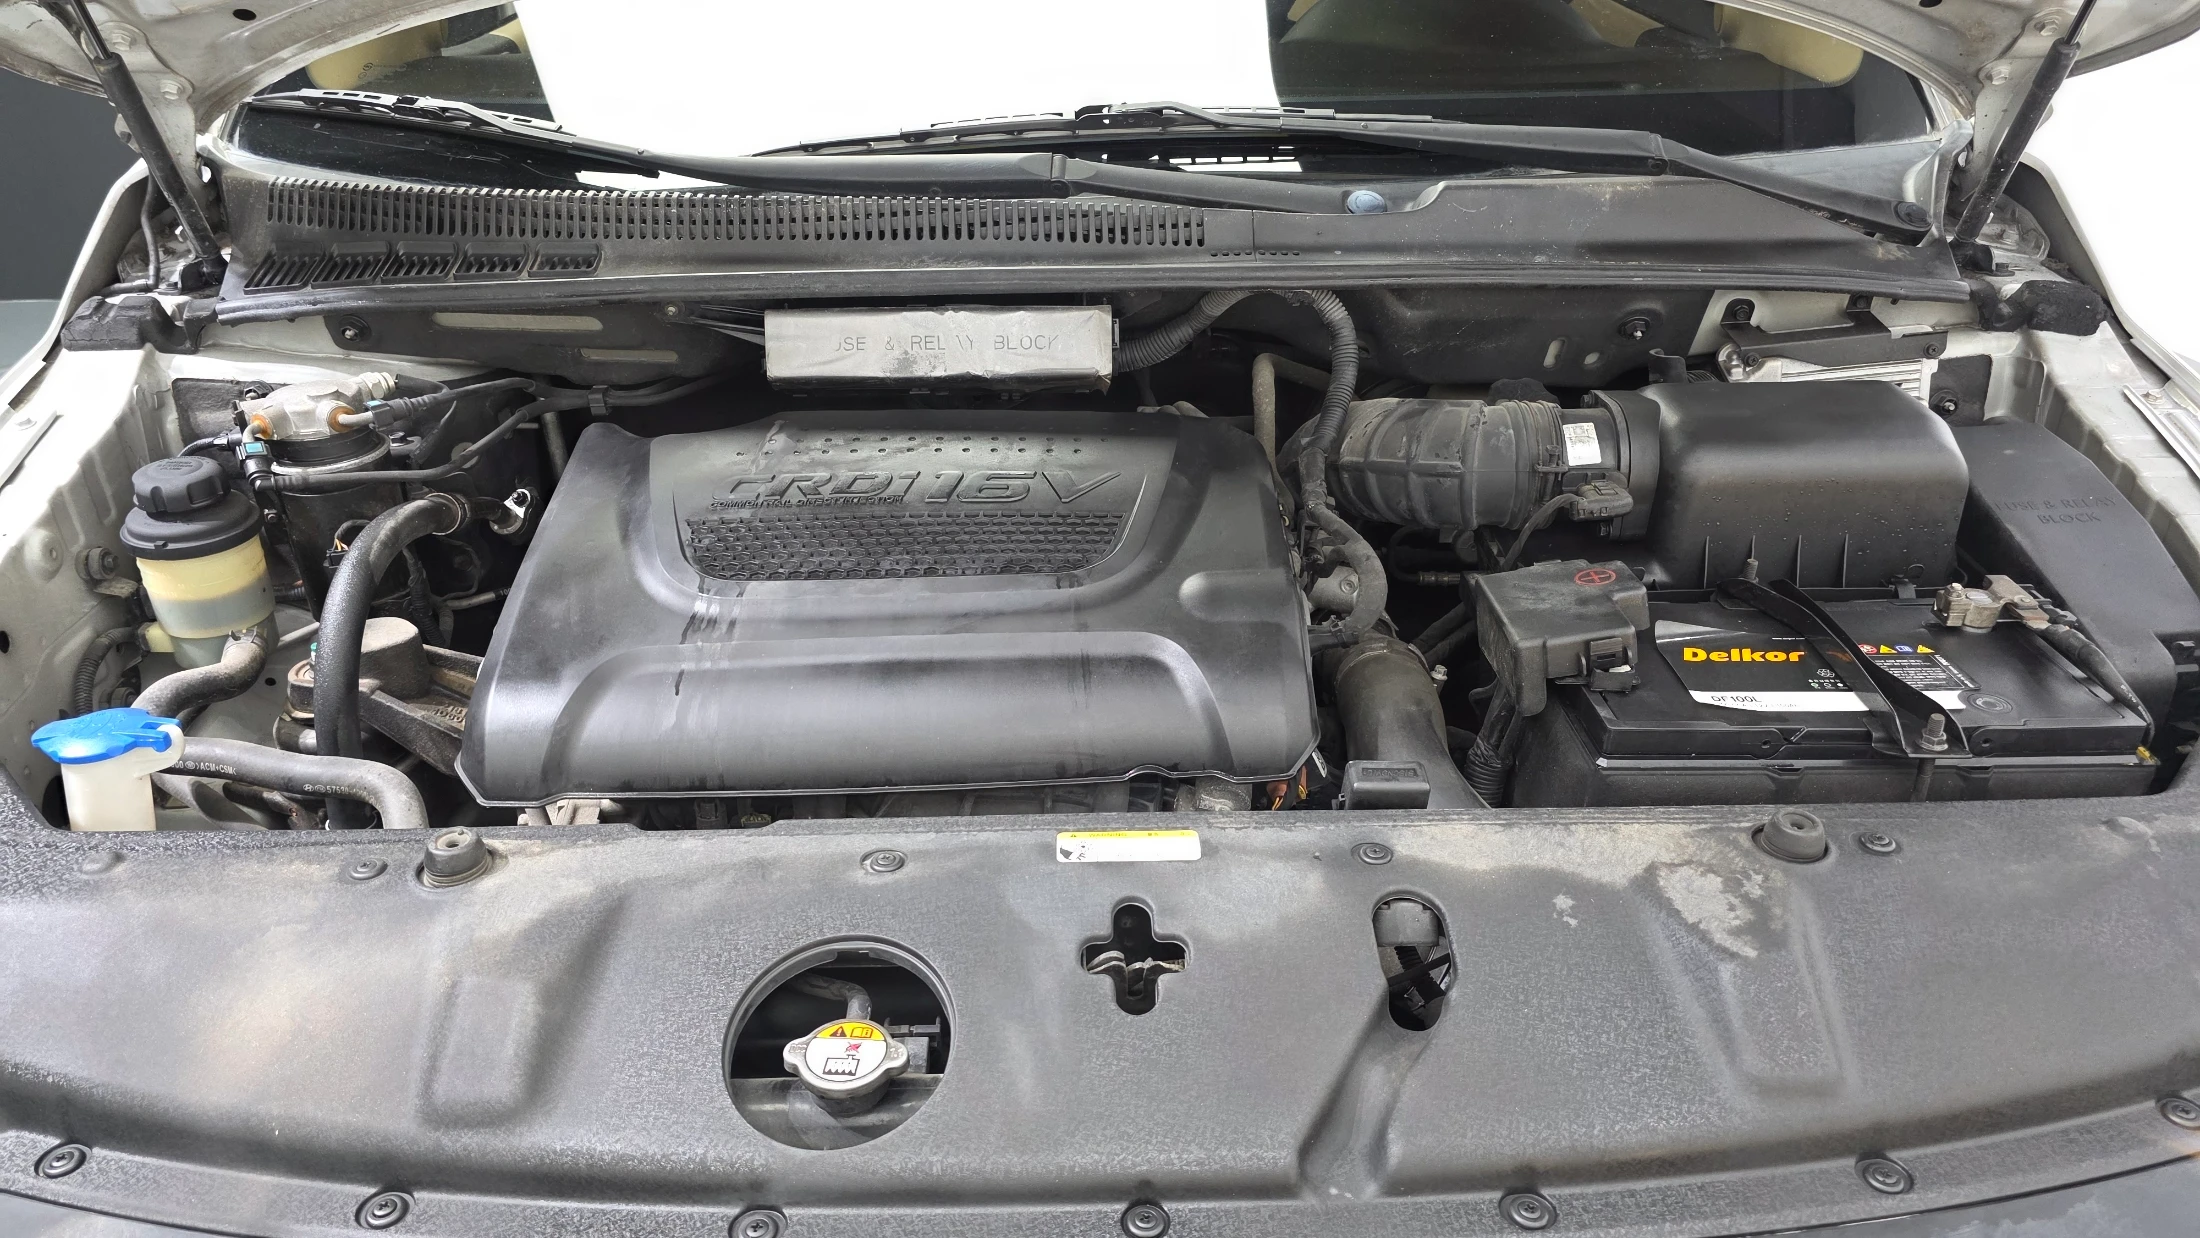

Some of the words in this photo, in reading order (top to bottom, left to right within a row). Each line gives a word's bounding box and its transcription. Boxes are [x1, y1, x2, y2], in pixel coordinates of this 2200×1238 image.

[884, 335, 895, 351] &
[993, 334, 1059, 350] BLOCK
[925, 470, 1121, 503] 16V
[710, 500, 763, 511] COMMON
[2043, 500, 2056, 510] &
[2060, 497, 2117, 509] RELAY
[2037, 511, 2101, 524] BLOCK
[1683, 646, 1806, 663] Delkor
